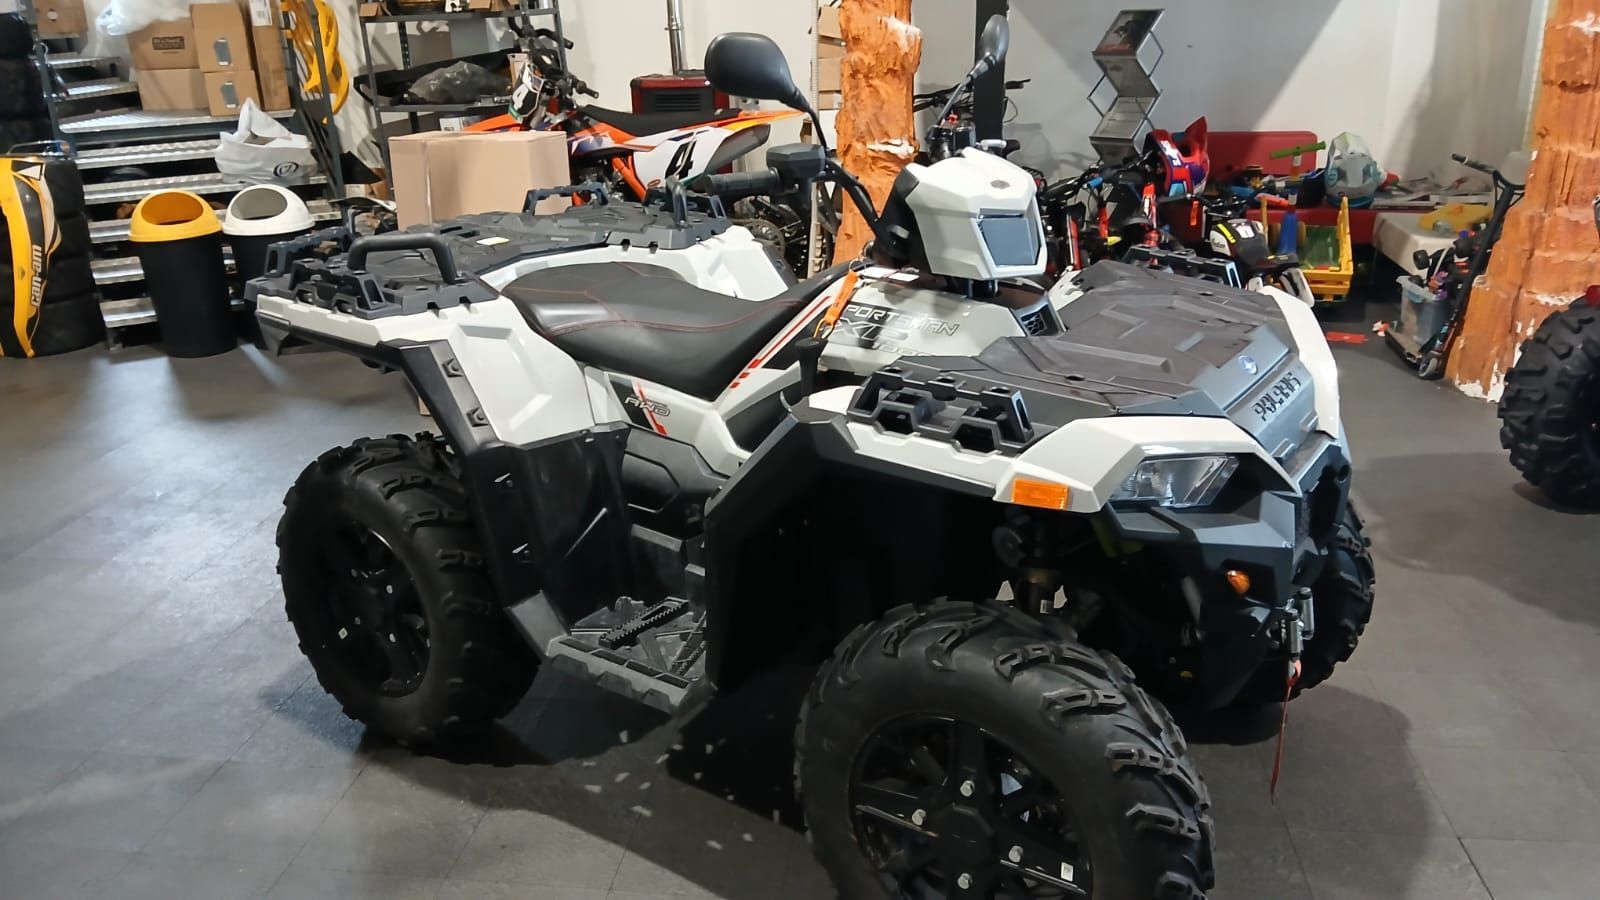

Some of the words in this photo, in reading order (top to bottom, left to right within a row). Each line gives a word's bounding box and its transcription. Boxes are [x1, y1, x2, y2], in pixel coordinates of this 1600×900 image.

[665, 140, 697, 180] 4
[31, 244, 42, 307] can-am
[845, 303, 960, 337] PORTSMAN
[624, 396, 671, 417] AWD
[1251, 371, 1302, 422] POLARIS
